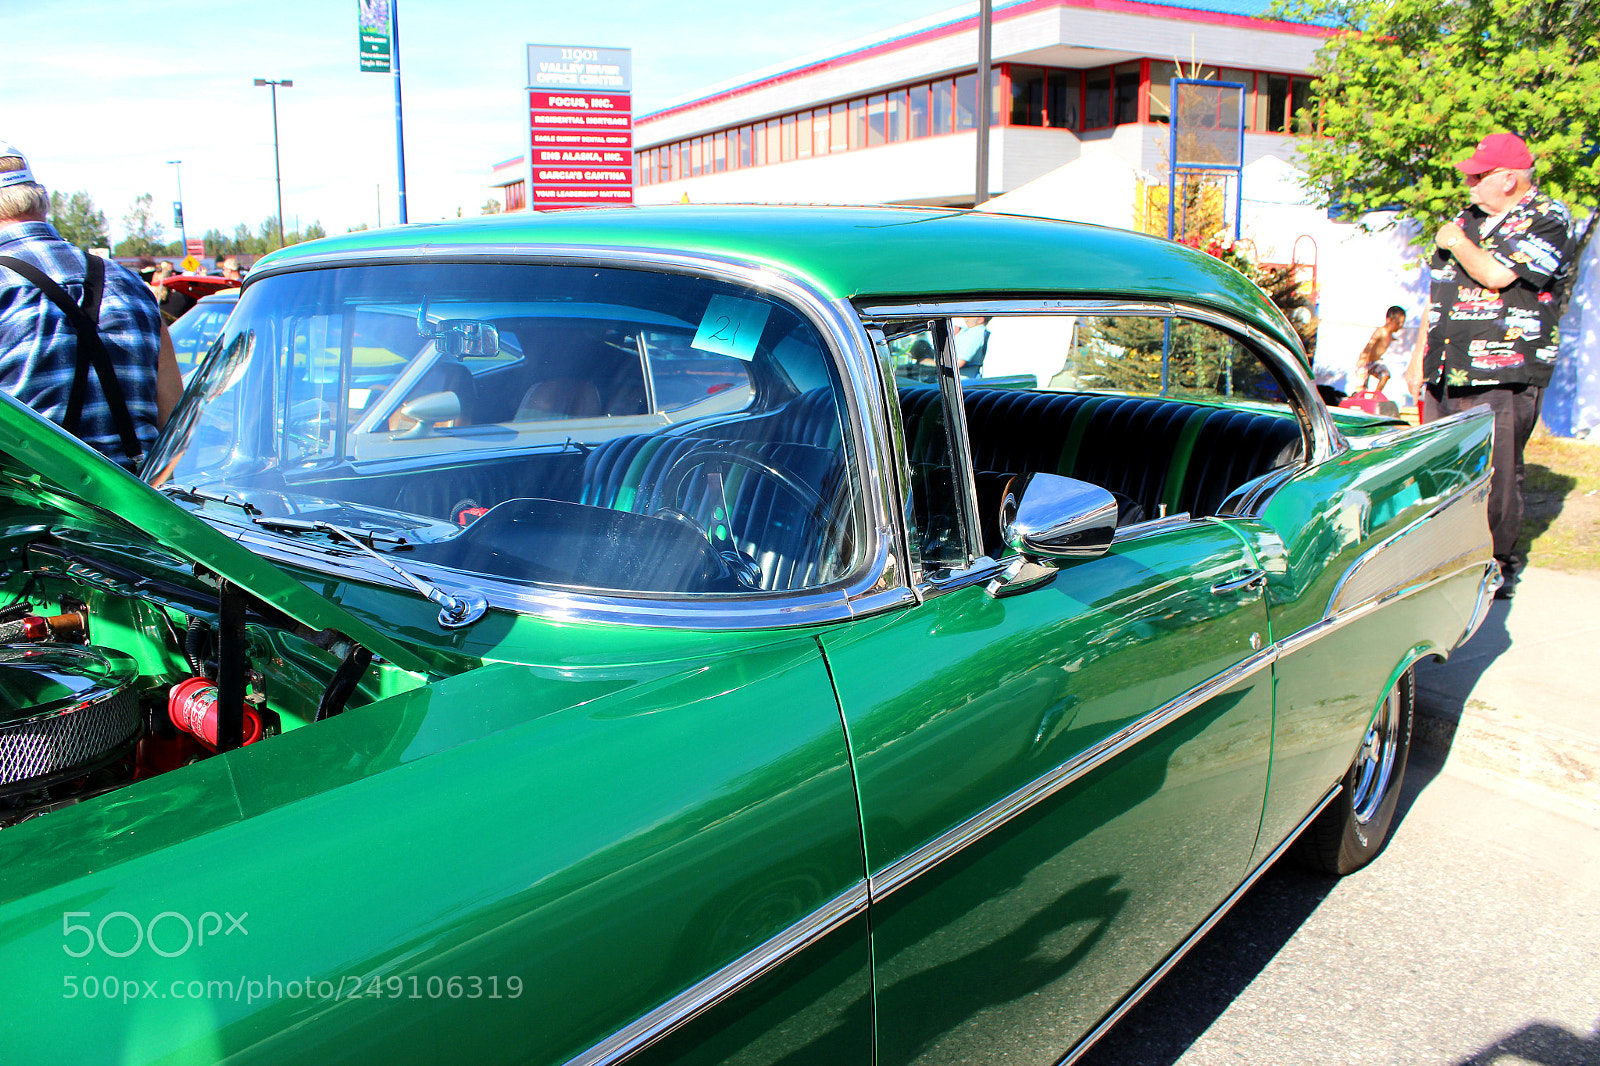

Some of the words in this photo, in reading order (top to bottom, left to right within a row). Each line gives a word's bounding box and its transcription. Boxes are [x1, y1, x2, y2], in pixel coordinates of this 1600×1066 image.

[561, 48, 597, 63] 11901
[540, 62, 584, 74] VALLEY
[585, 64, 620, 75] RIVER
[536, 72, 578, 84] OFFICE
[579, 74, 624, 86] CENTER
[549, 96, 589, 109] FOCUS,
[591, 98, 614, 108] INC.
[534, 116, 585, 125] RESIDENTIAL
[586, 117, 628, 125] MORTGAGE
[562, 152, 602, 162] ALASKA,
[604, 153, 624, 161] INC.
[539, 171, 583, 180] GARCIA'S
[584, 171, 626, 180] CANTINA
[708, 316, 741, 347] 21
